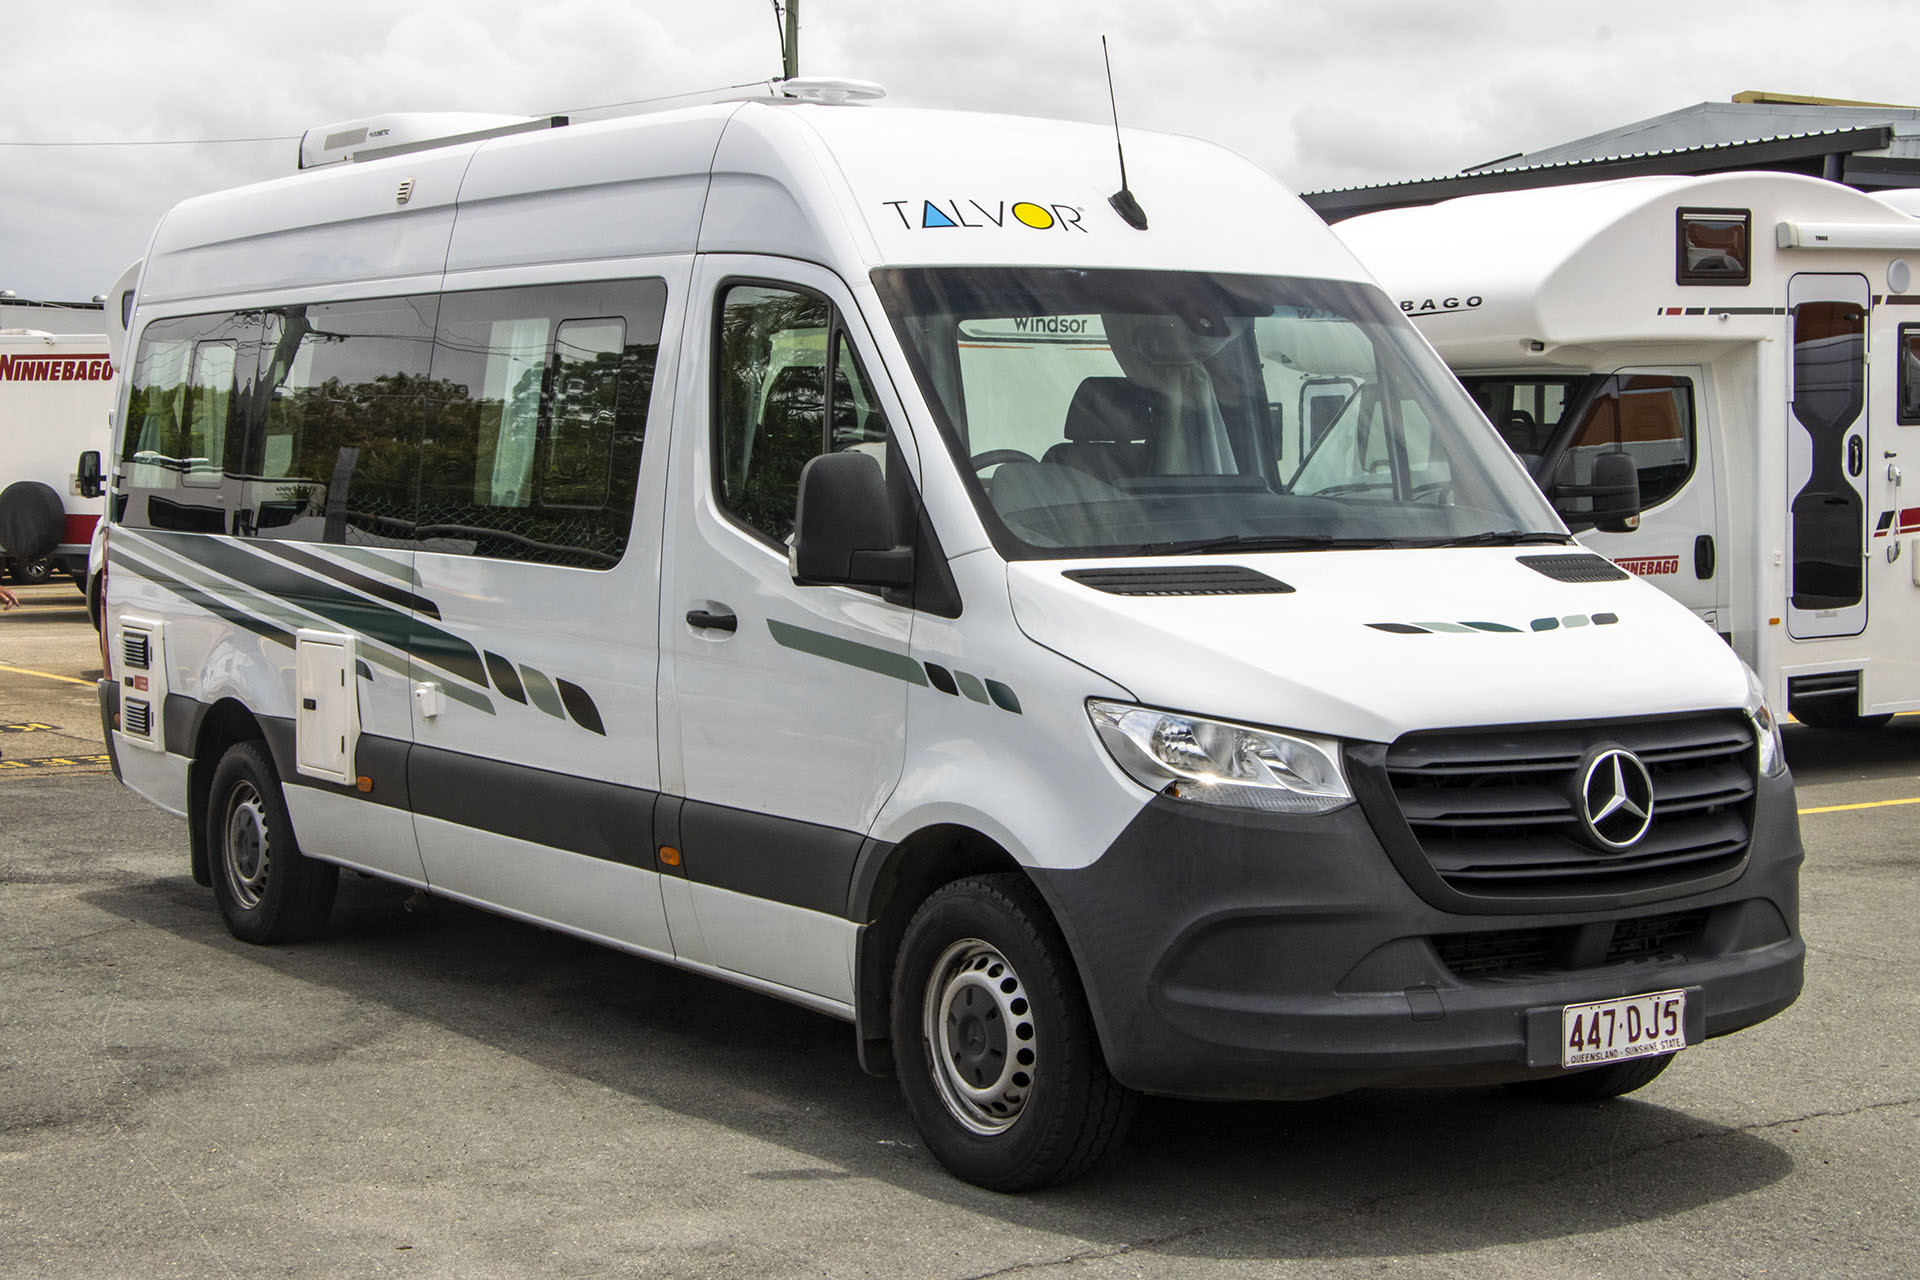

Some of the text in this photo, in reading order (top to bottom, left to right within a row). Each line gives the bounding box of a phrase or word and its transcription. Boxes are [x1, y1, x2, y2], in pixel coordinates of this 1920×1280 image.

[1400, 296, 1482, 311] BAGO
[1570, 1048, 1619, 1063] QUEENSLAND
[1624, 1042, 1658, 1056] SUNSHINE
[1660, 1038, 1681, 1050] STATE
